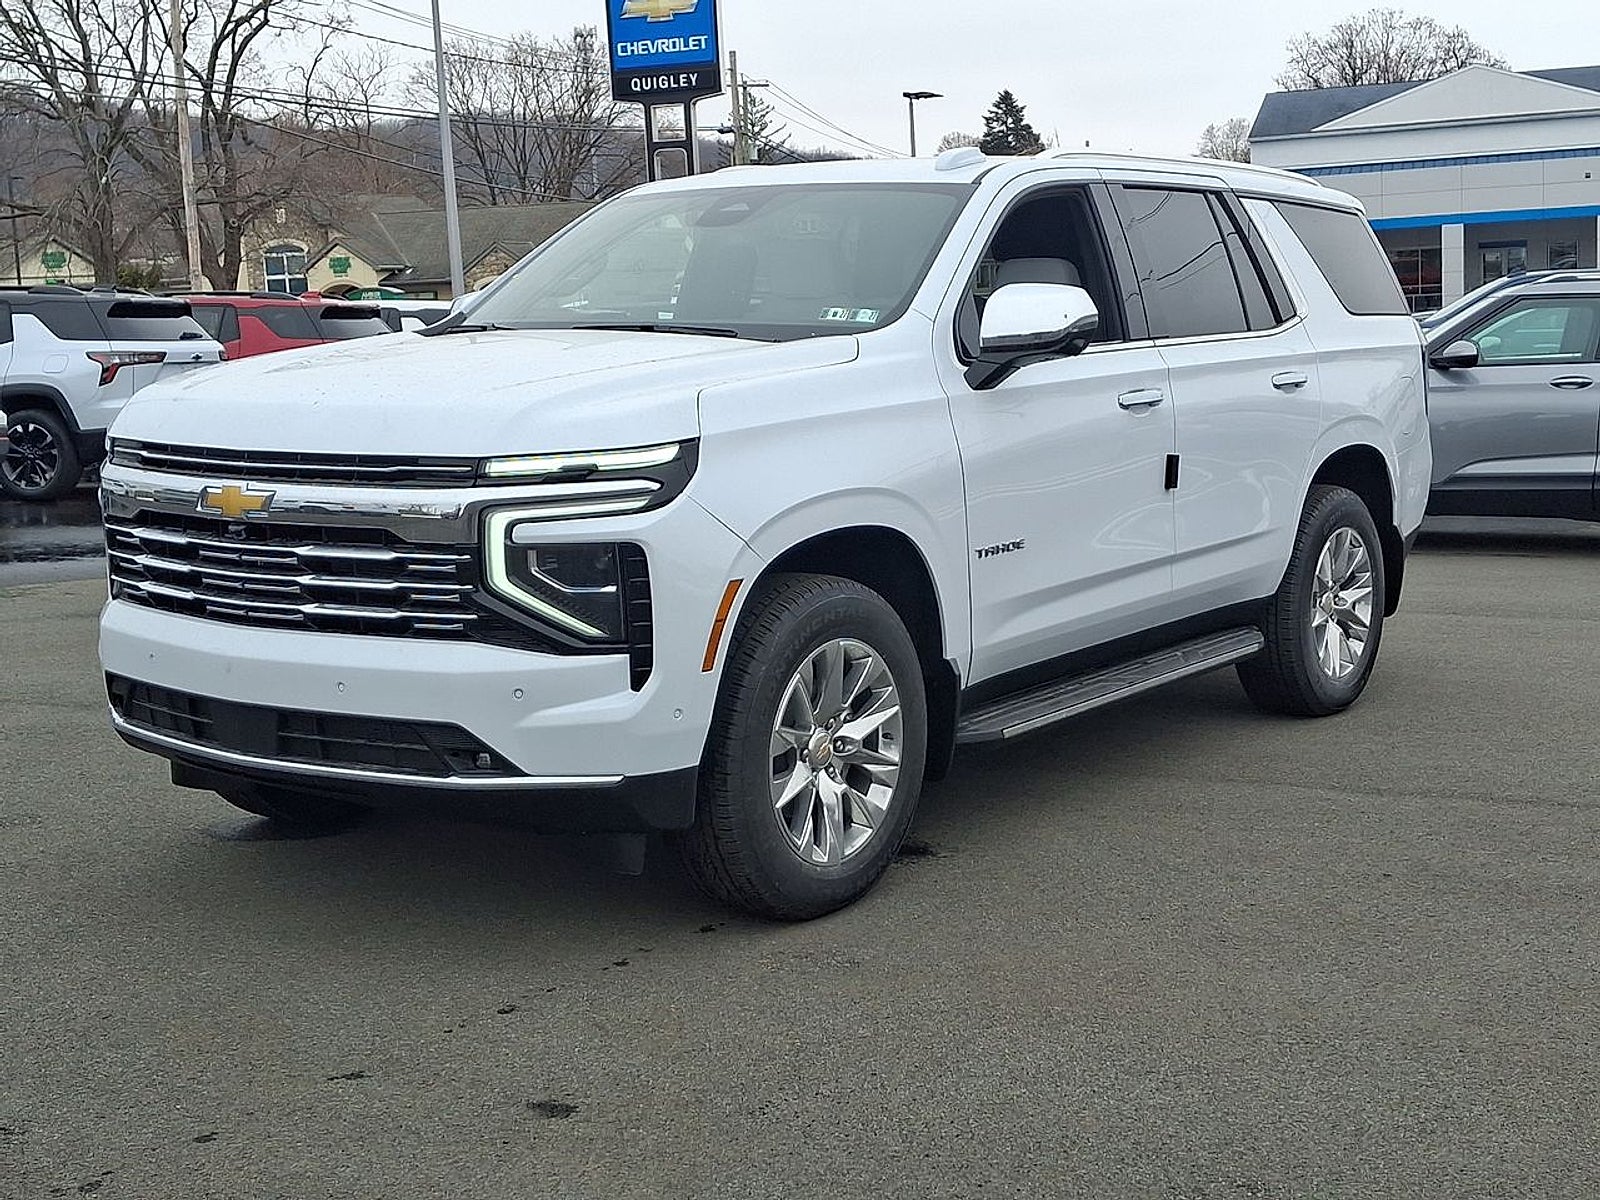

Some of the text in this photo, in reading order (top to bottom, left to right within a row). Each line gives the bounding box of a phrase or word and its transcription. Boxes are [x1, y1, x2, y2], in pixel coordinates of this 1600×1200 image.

[617, 35, 708, 56] CHEVROLET
[631, 73, 698, 91] QUIGLEY
[975, 538, 1026, 559] TAHOE
